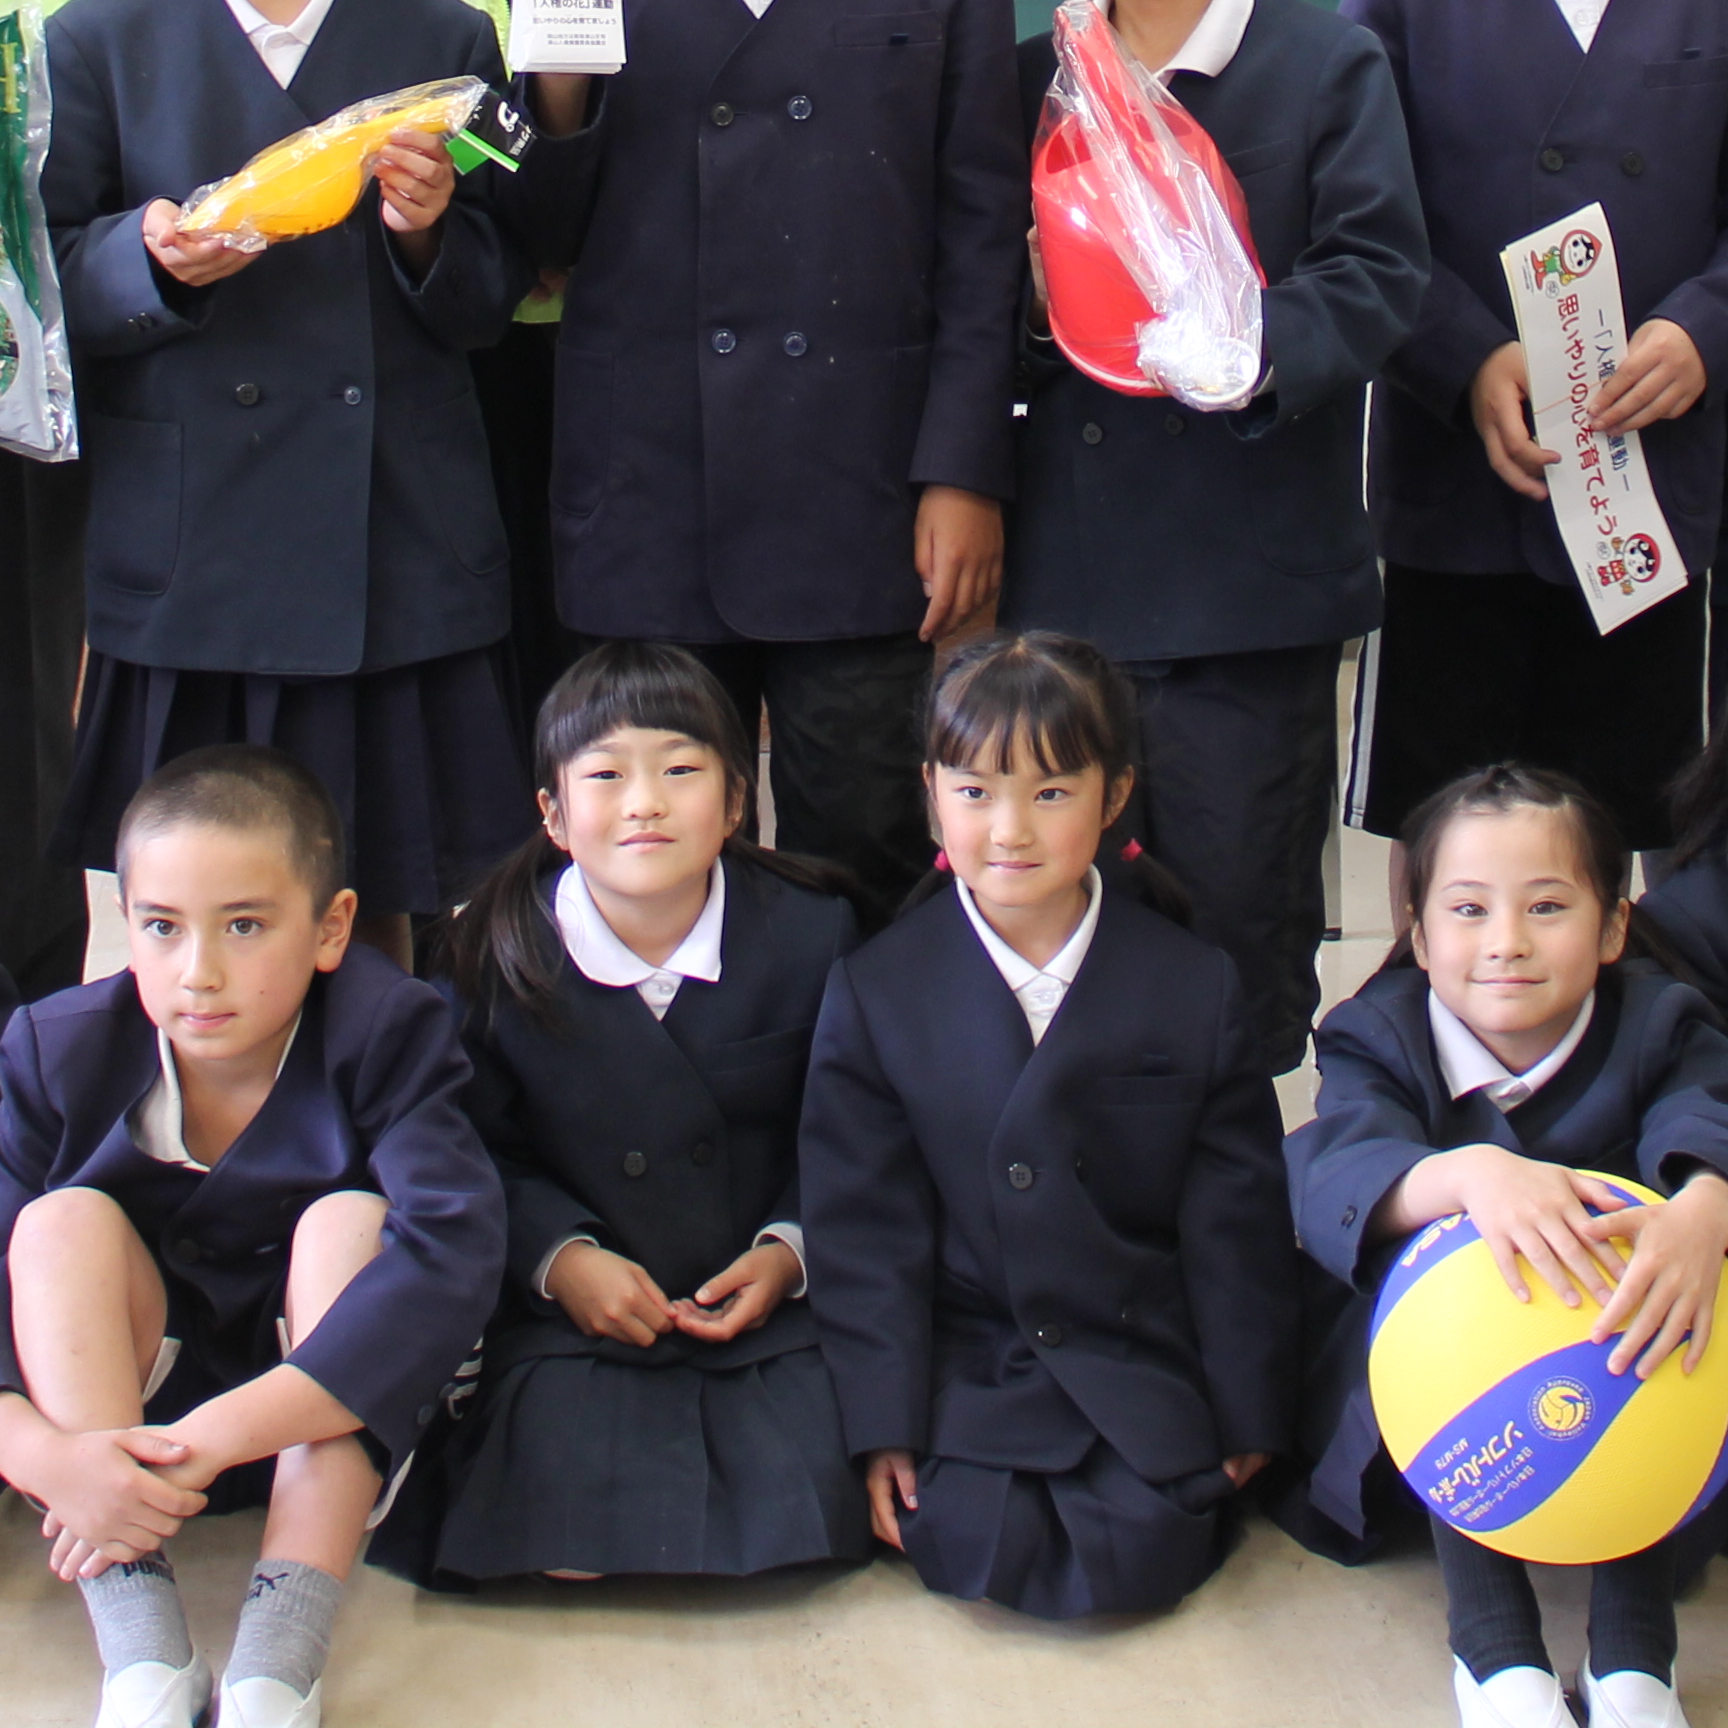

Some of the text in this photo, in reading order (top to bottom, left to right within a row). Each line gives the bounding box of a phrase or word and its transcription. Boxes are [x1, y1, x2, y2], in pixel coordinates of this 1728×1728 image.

[1427, 1420, 1525, 1504] ソフトバレーボール
